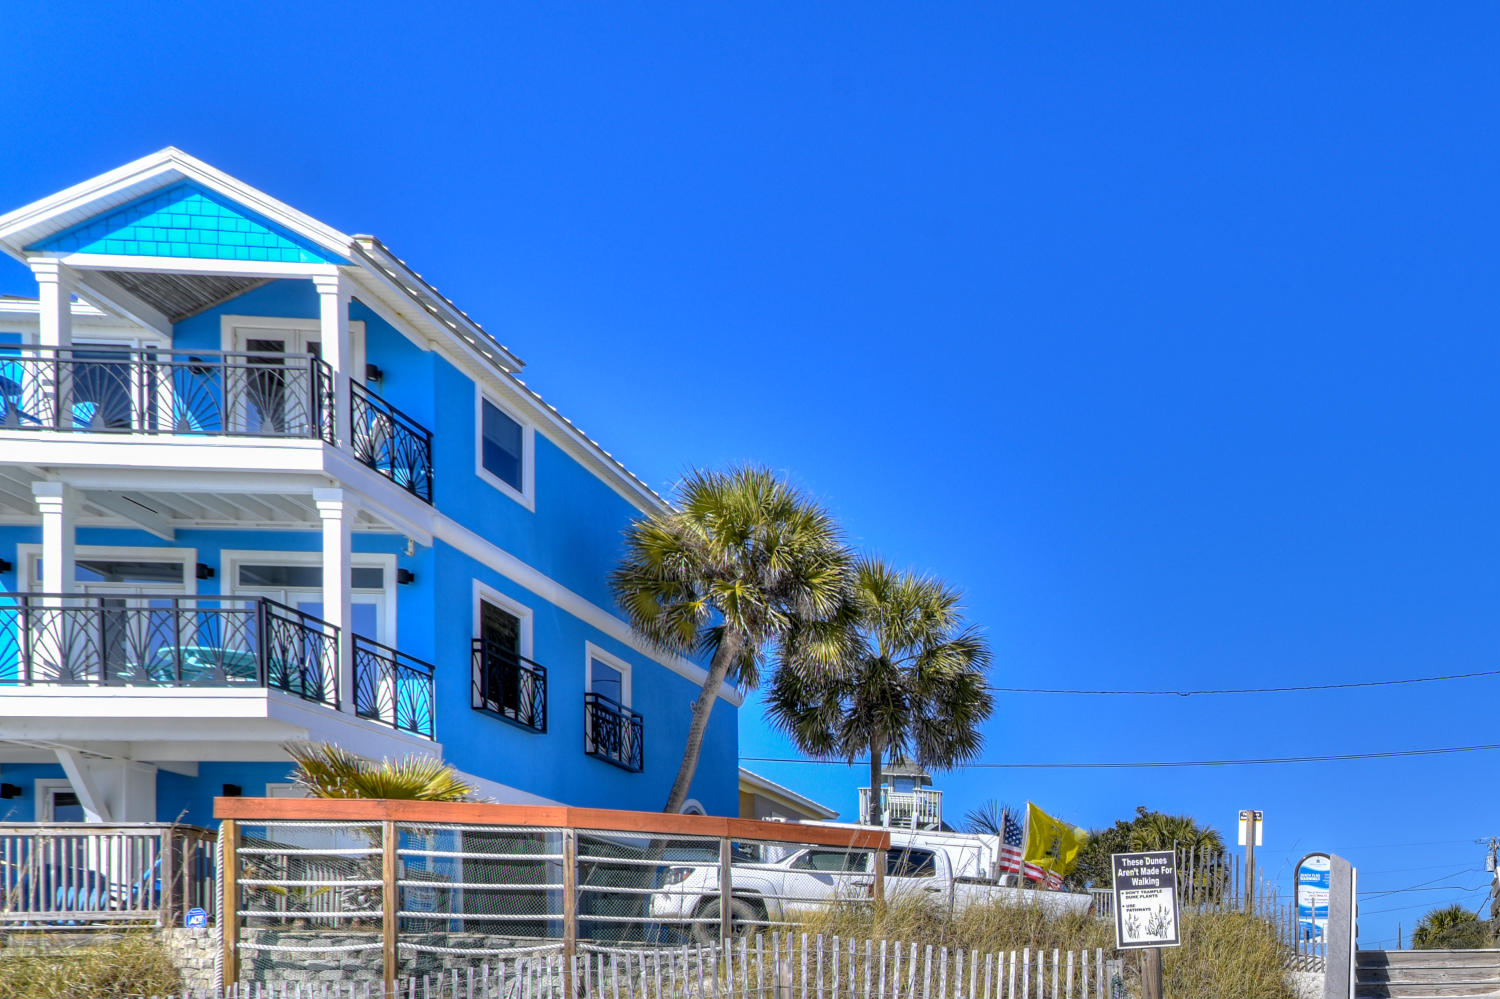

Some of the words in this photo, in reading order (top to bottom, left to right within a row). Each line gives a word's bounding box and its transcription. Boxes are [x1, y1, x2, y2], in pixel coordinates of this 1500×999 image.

[1121, 858, 1144, 866] These
[1145, 856, 1167, 865] Dunes
[1117, 867, 1139, 877] Aren't
[1140, 867, 1159, 875] Made
[1161, 866, 1173, 875] For
[1131, 877, 1160, 887] Walking
[189, 915, 203, 924] ADT
